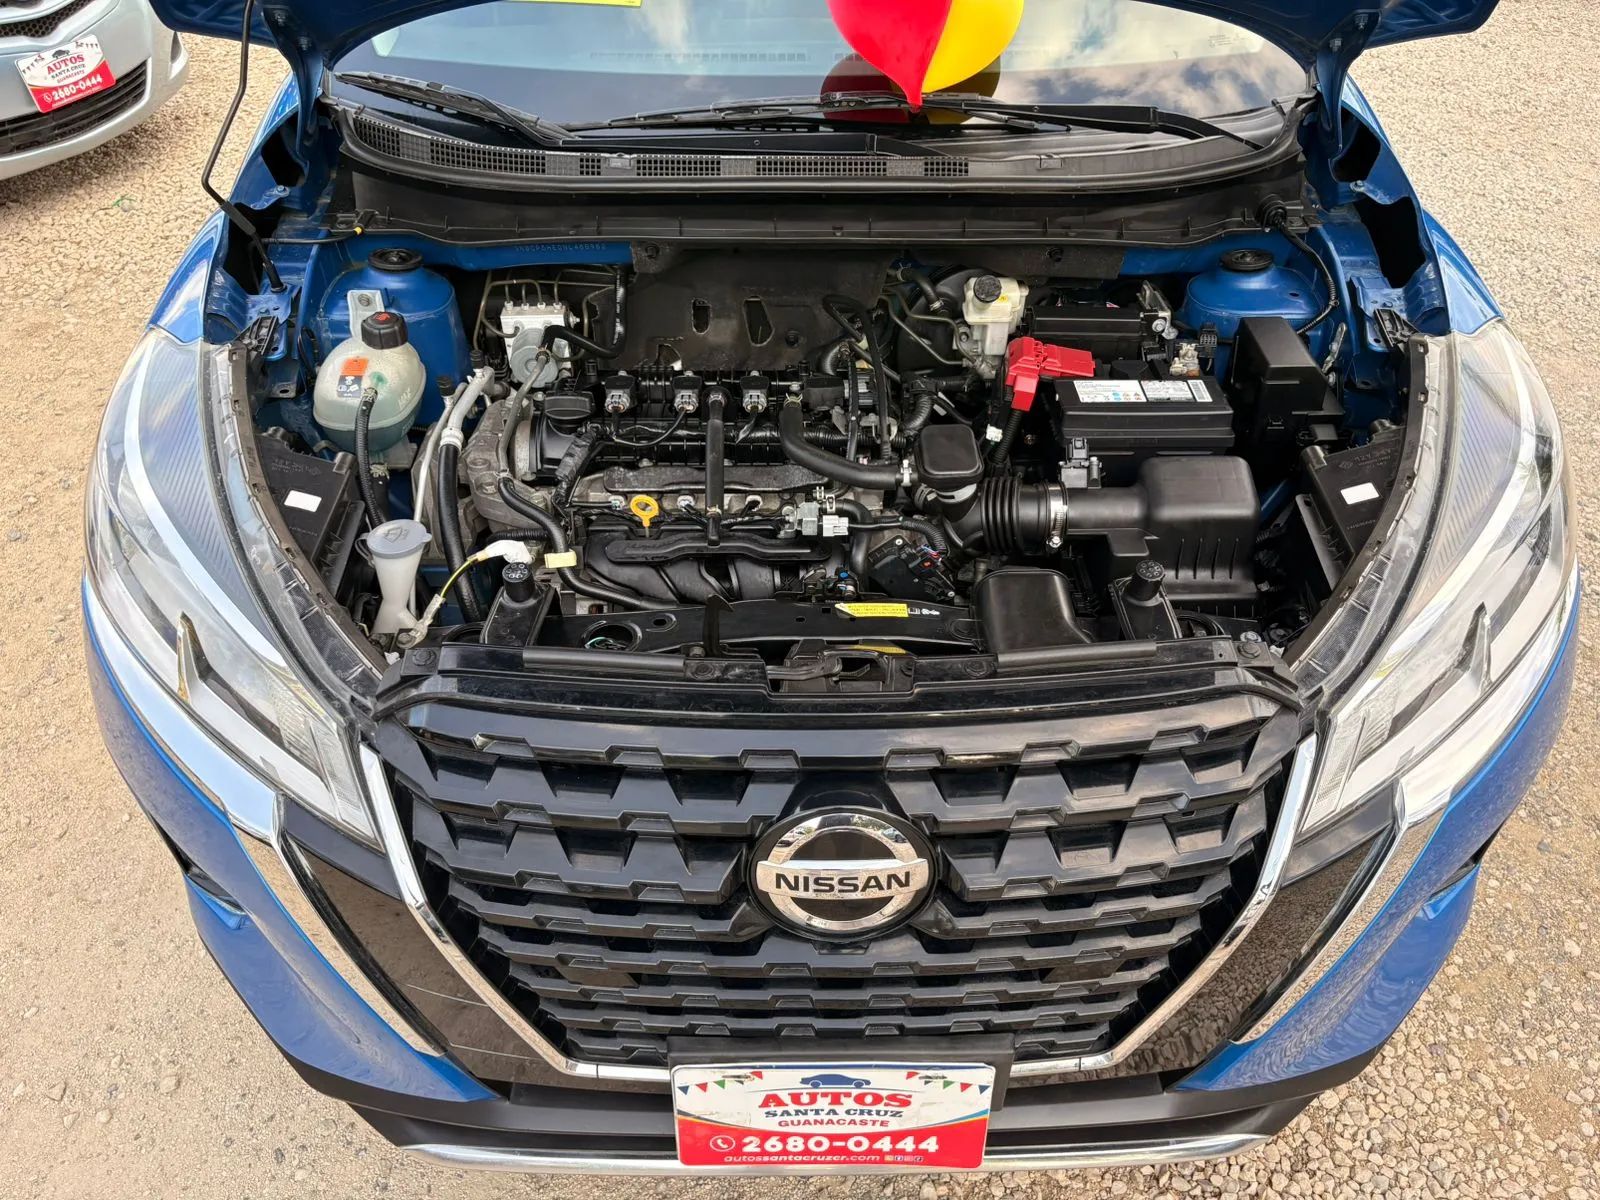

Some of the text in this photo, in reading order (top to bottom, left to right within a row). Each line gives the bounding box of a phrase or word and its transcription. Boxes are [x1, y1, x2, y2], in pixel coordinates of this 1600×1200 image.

[47, 54, 85, 75] AUTOS
[51, 68, 71, 79] SANTA
[52, 74, 103, 100] 2680-0444
[775, 871, 911, 893] NISSAN
[758, 1092, 913, 1109] AUTOS
[764, 1108, 904, 1118] SANTA CRUZ
[778, 1118, 890, 1128] GUANACASTE
[741, 1135, 939, 1153] 2680-0444
[723, 1153, 880, 1163] autossantacruzcr.com
